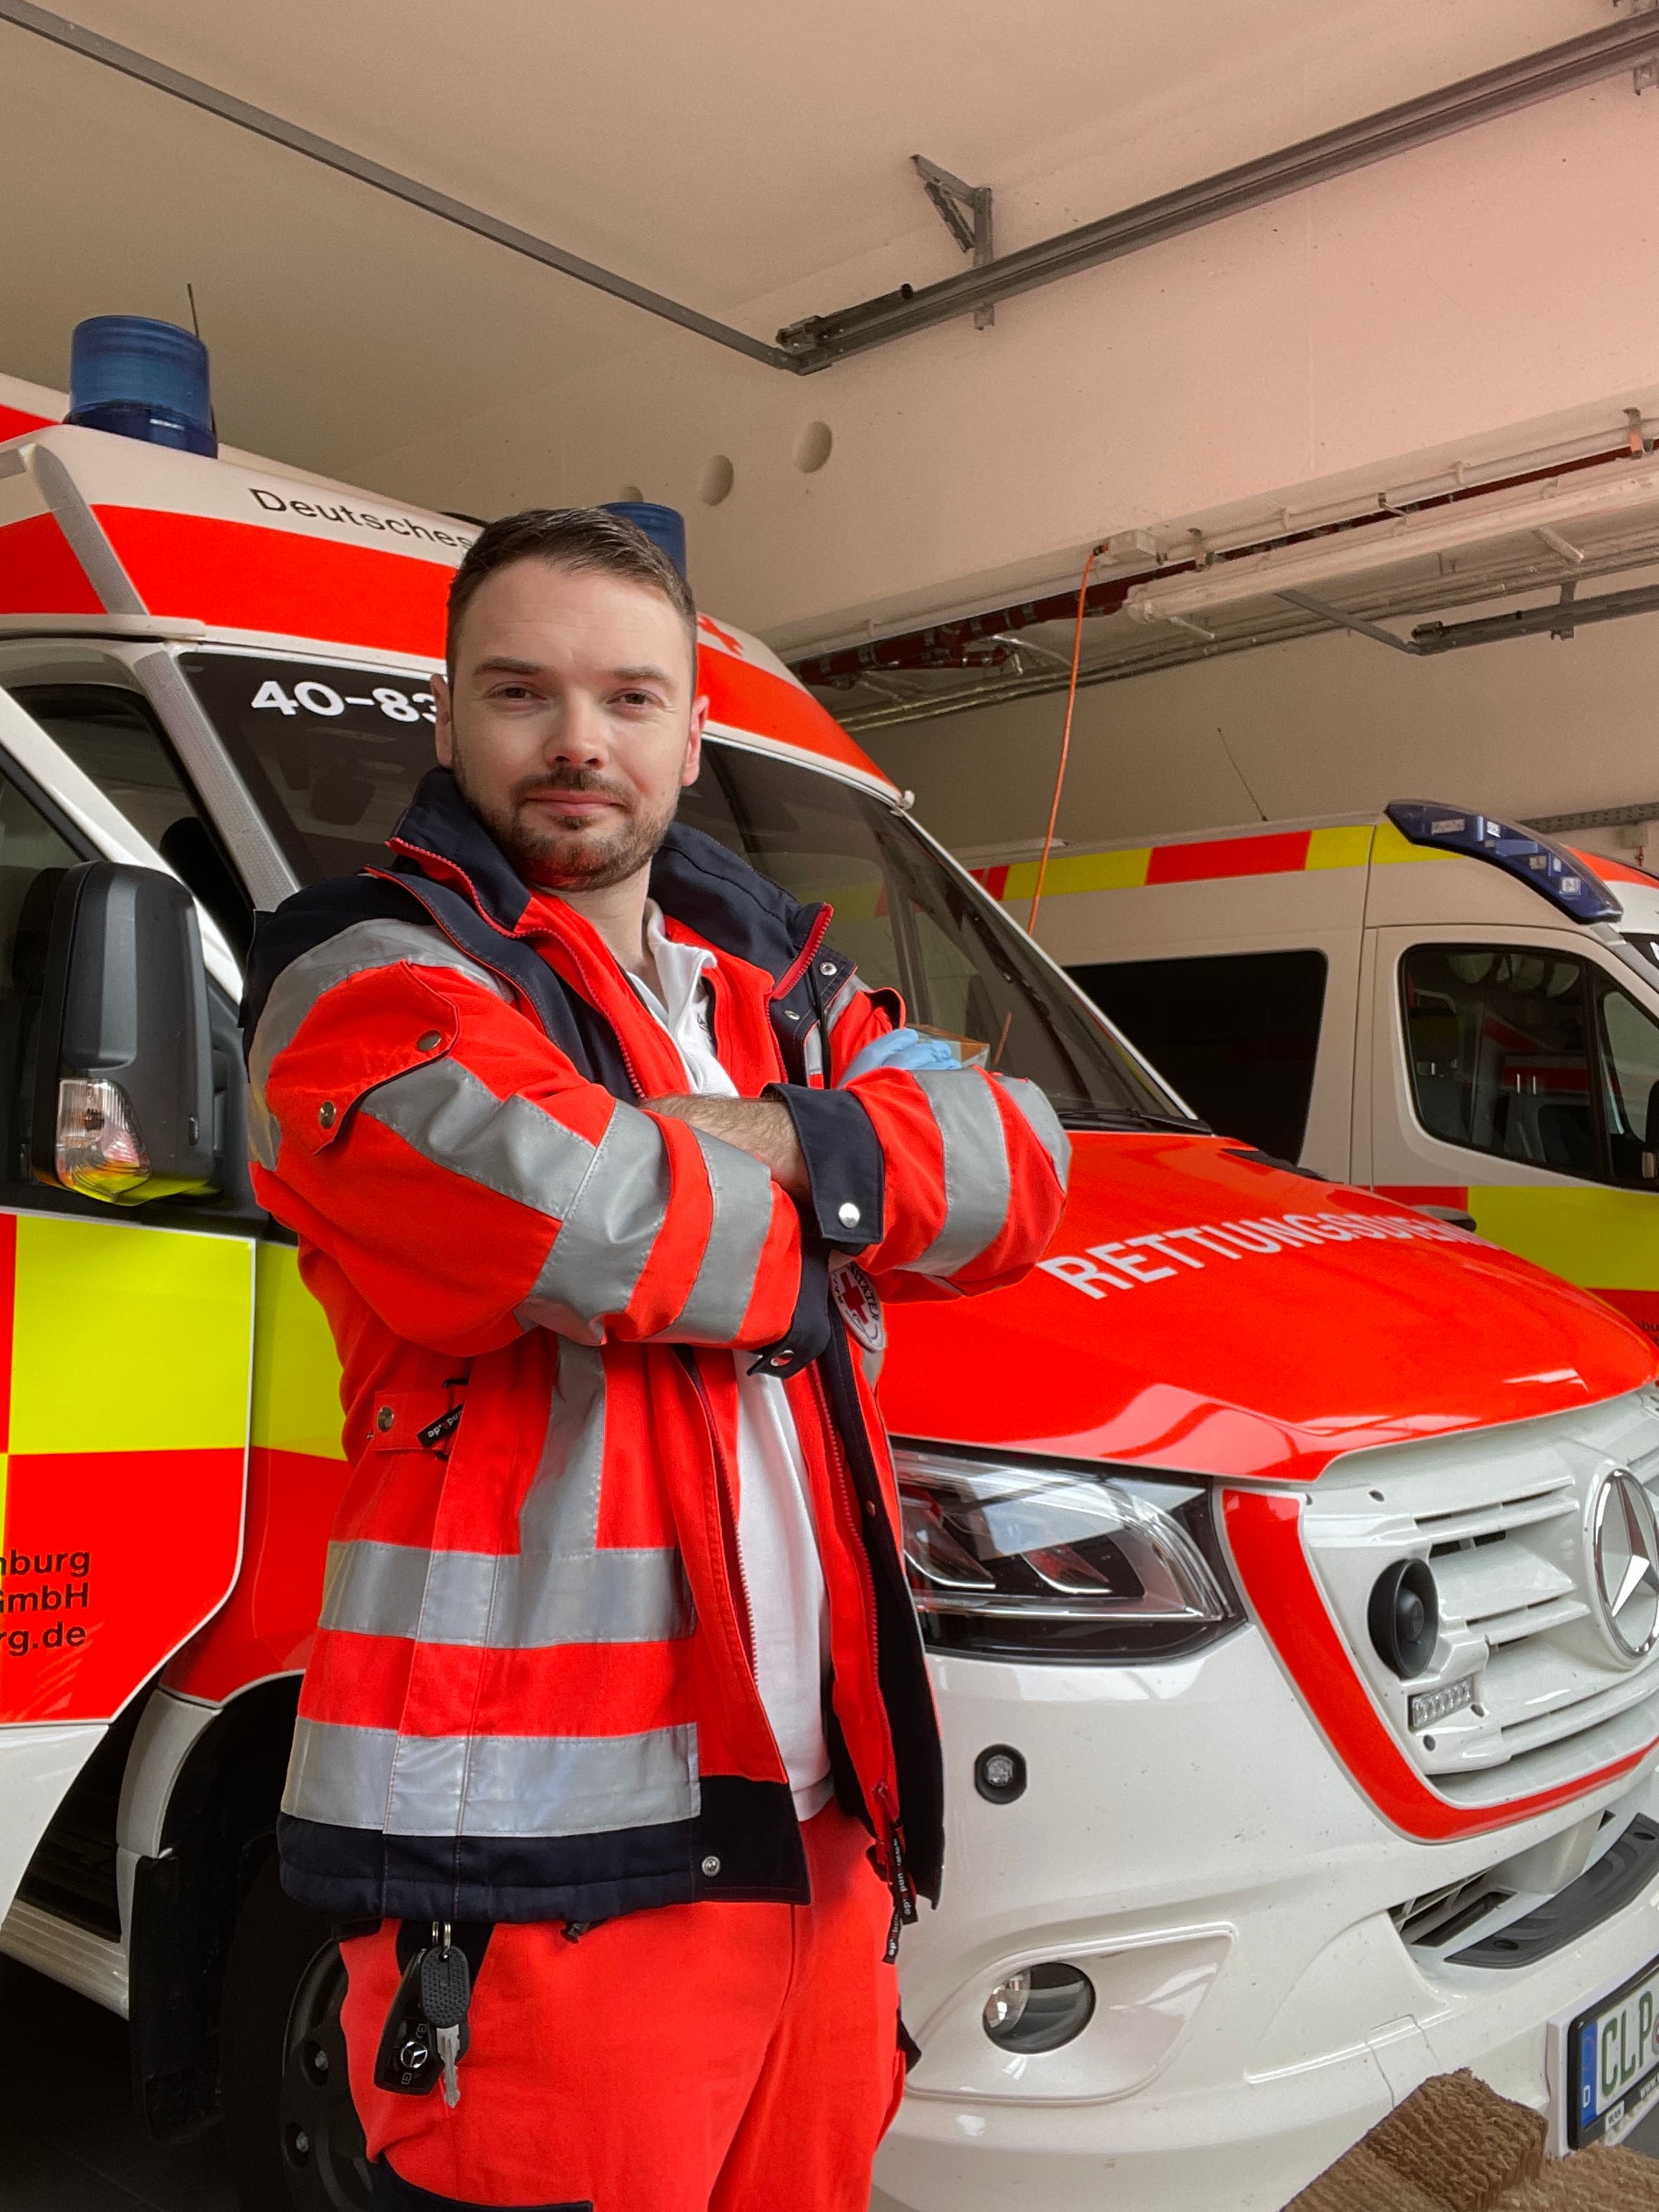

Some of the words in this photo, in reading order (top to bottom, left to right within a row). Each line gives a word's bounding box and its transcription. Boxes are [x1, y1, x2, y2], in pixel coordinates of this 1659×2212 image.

[249, 487, 473, 551] Deutsches
[0, 1581, 90, 1613] mbH
[1601, 1990, 1653, 2097] CLP
[1582, 2085, 1591, 2109] D
